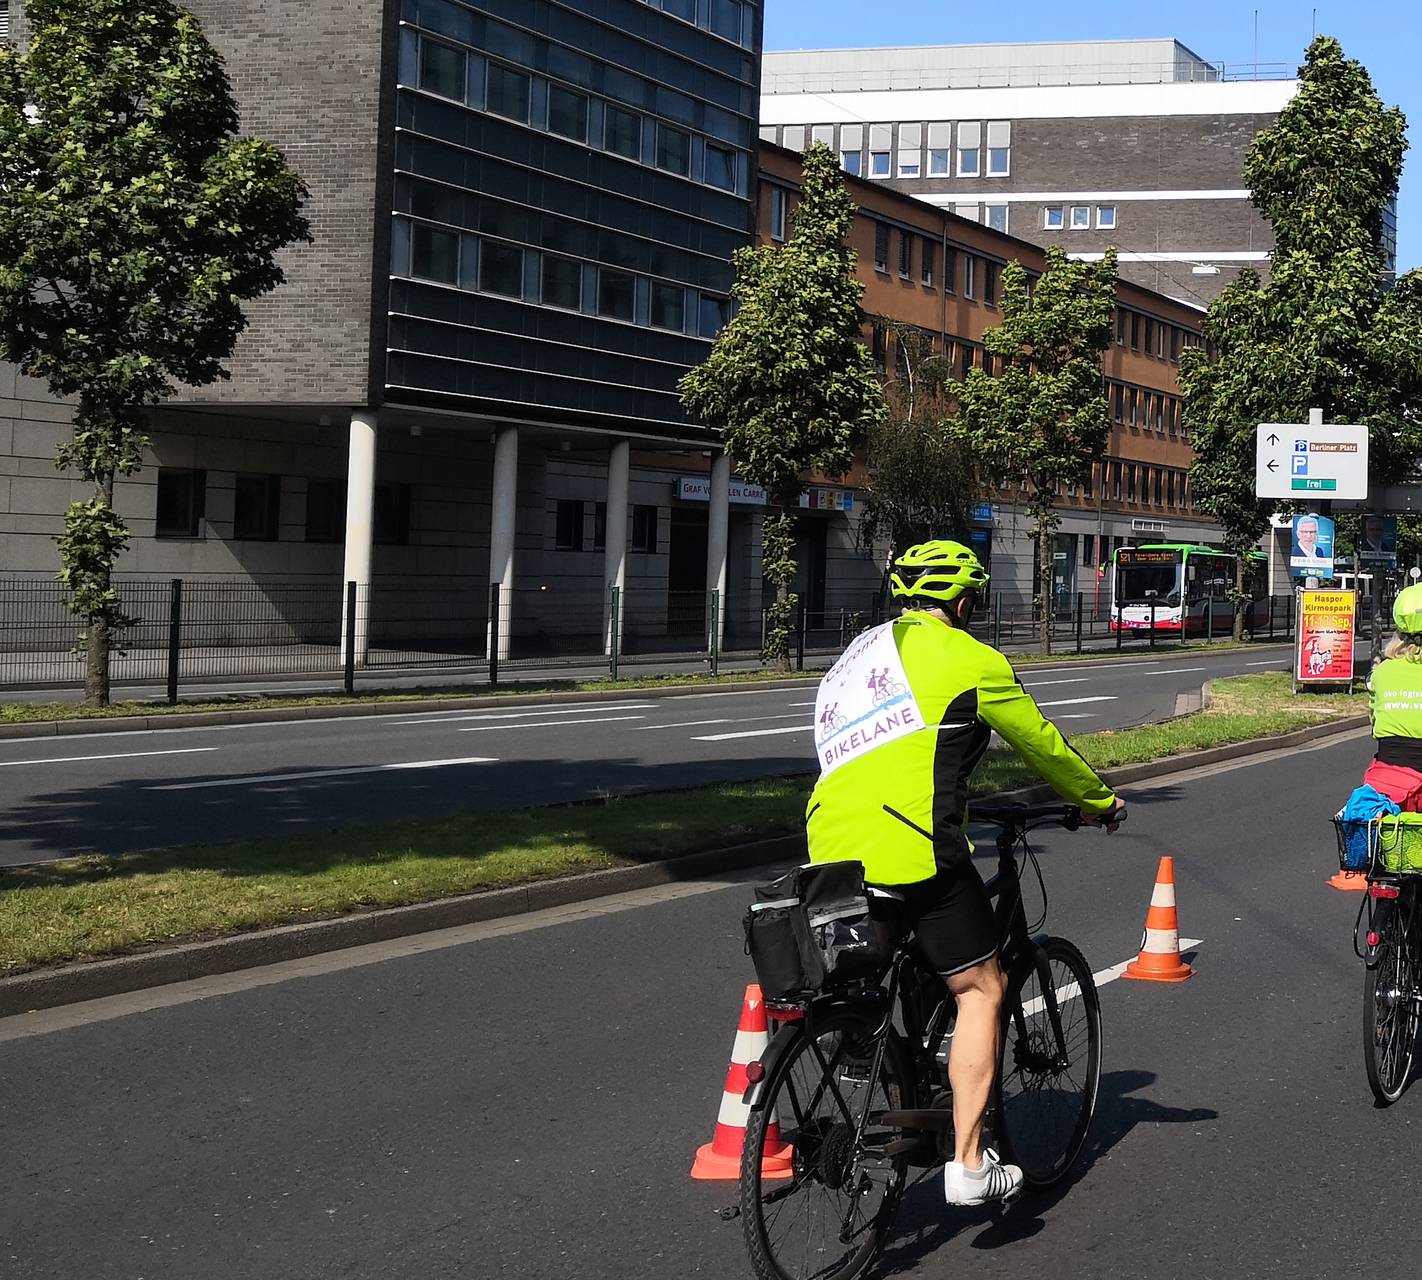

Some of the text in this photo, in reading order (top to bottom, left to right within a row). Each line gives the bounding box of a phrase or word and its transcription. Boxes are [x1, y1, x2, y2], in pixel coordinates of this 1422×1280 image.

[1294, 457, 1307, 474] P
[1306, 480, 1322, 489] frei
[1314, 595, 1344, 603] Hasper
[1305, 604, 1352, 613] Kirmespark
[1332, 615, 1352, 629] Sep.
[824, 707, 915, 767] BIKELANE
